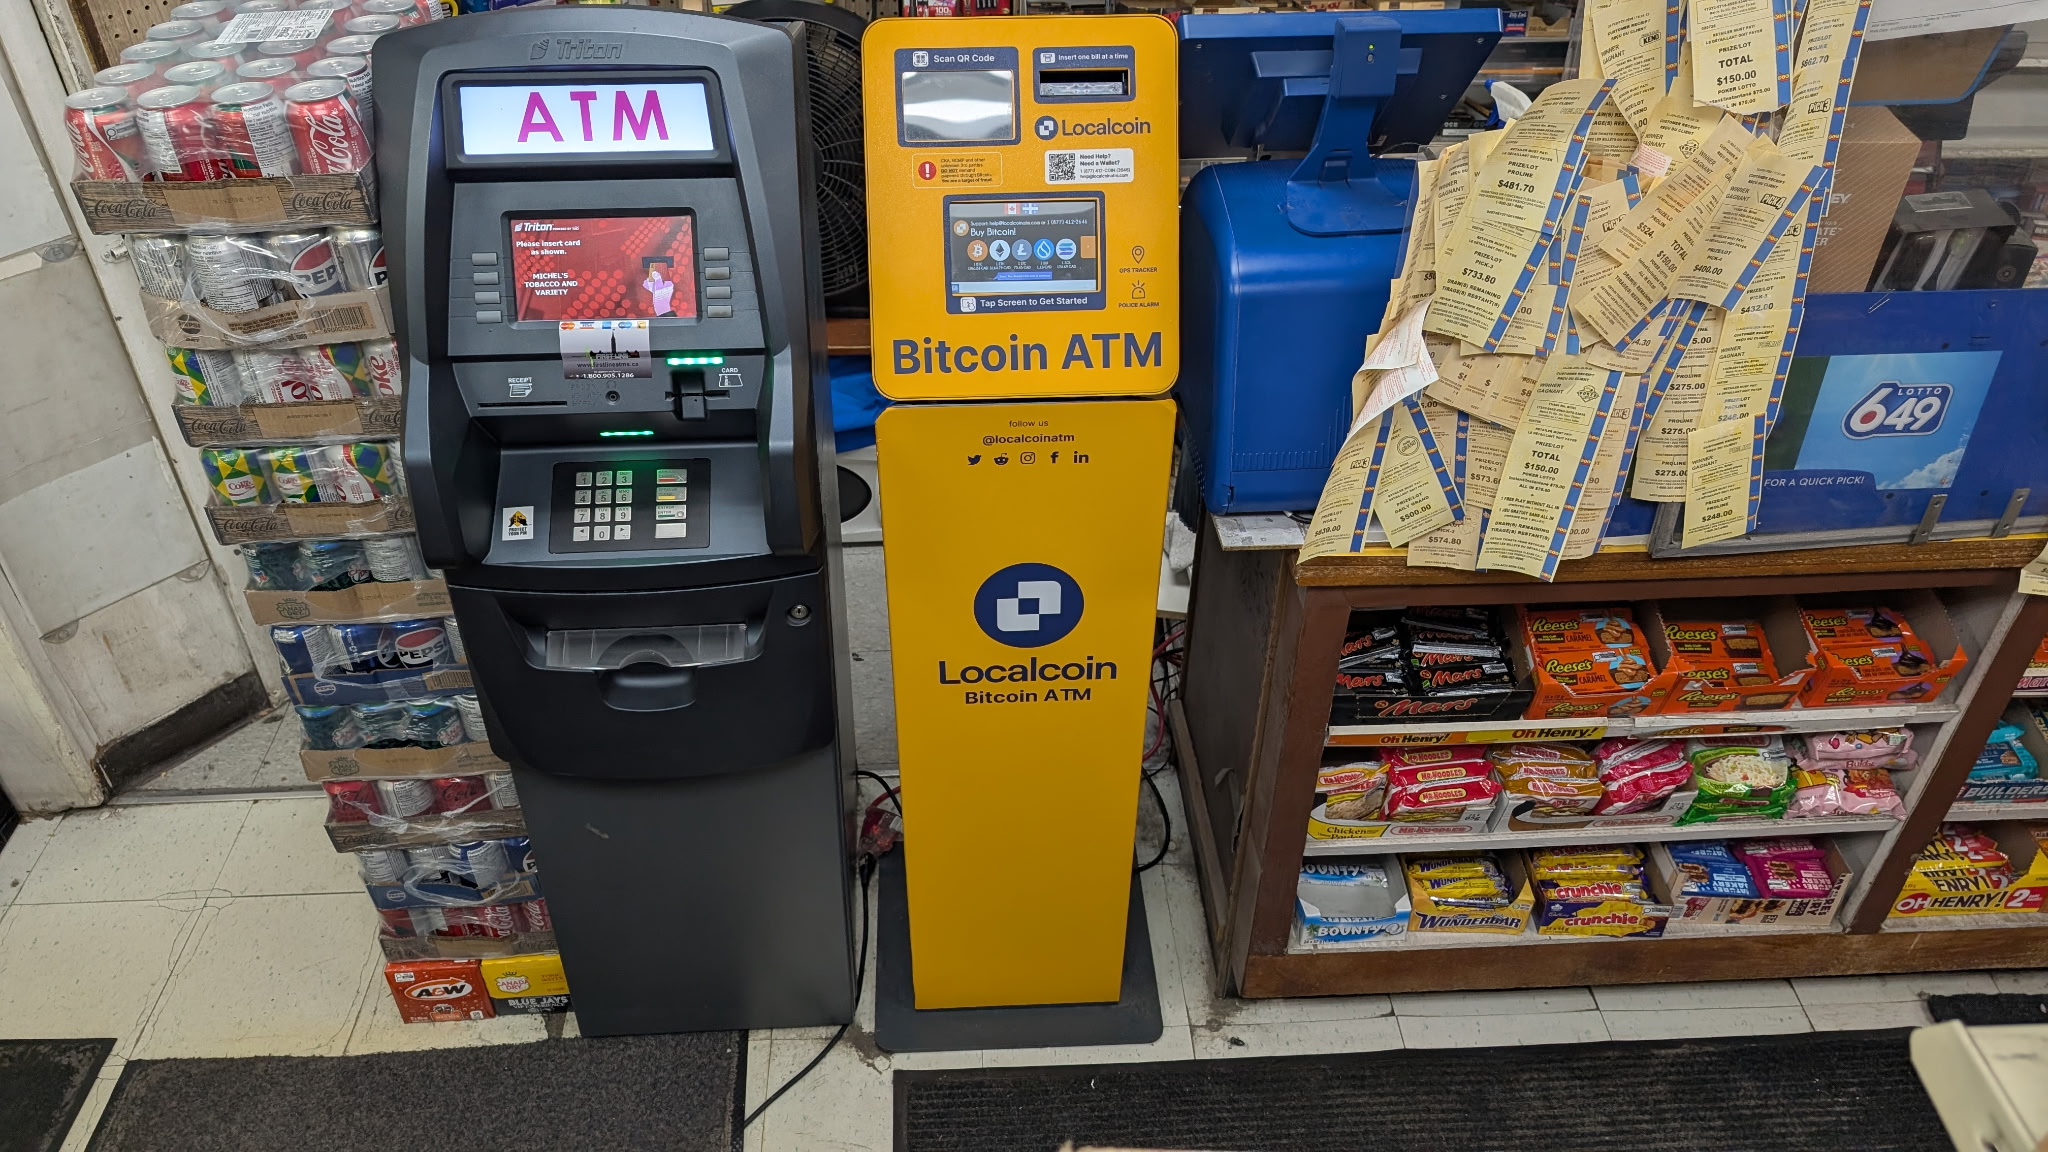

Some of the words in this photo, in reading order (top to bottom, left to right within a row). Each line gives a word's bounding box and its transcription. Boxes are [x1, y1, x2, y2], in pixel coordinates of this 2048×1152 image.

[1644, 34, 1660, 45] KENO
[557, 39, 624, 61] Triton
[1718, 42, 1753, 54] PRIZE/LOT
[934, 54, 955, 64] Scan
[957, 54, 970, 64] QR
[972, 54, 995, 63] Code
[1718, 55, 1754, 69] TOTAL
[1717, 70, 1757, 87] $150.00
[1718, 86, 1738, 95] POKER
[1738, 83, 1757, 92] LOTTO
[517, 90, 670, 143] ATM
[1062, 117, 1151, 137] Localcoin
[1508, 161, 1539, 171] PRIZE/LOT
[1508, 170, 1533, 179] PROLINE
[1498, 180, 1535, 194] $481.70
[524, 222, 554, 232] Triton
[970, 228, 984, 237] Buy
[987, 227, 1016, 236] Bitcoin!
[564, 239, 581, 247] card
[1671, 240, 1689, 261] TOTAL
[1474, 251, 1503, 264] PRIZE/LOT
[1657, 251, 1678, 273] $150.00
[1693, 264, 1723, 276] $400.00
[1462, 268, 1496, 285] $733.80
[524, 281, 561, 289] TOBACCO
[562, 280, 579, 288] AND
[1447, 279, 1469, 290] DRAW(S)
[1469, 285, 1502, 300] REMAINING
[980, 300, 996, 308] Tap
[998, 298, 1027, 307] Screen
[1056, 297, 1088, 305] Started
[1468, 292, 1500, 308] RESTANT(S)
[1741, 303, 1774, 315] $432.00
[893, 334, 1048, 375] Bitcoin
[1062, 332, 1163, 370] ATM
[508, 377, 533, 385] RECEIPT
[1670, 383, 1706, 391] $275.00
[1898, 388, 1943, 396] LOTTO
[1850, 386, 1943, 434] 649
[1009, 420, 1036, 428] follow
[983, 434, 1075, 446] @localcoinatm
[1536, 441, 1565, 450] PRIZE/LOT
[1532, 450, 1561, 462] TOTAL
[1475, 458, 1503, 467] PRIZE/LOT
[1524, 462, 1559, 475] $150.00
[583, 477, 587, 485] 1
[601, 477, 608, 485] 2
[622, 476, 628, 484] 3
[1764, 479, 1786, 489] FOR
[1789, 478, 1797, 488] A
[1800, 476, 1833, 488] QUICK
[1836, 476, 1865, 486] PICK!
[601, 495, 607, 503] 5
[621, 494, 628, 502] 6
[1396, 492, 1423, 506] PRIZE/LOT
[1705, 496, 1732, 506] PRIZE/LOT
[1400, 504, 1432, 522] $500.00
[1707, 503, 1729, 511] PROLINE
[579, 514, 586, 522] 7
[600, 513, 606, 521] 8
[621, 512, 627, 520] 9
[1702, 510, 1733, 523] $248.00
[599, 531, 606, 539] 0
[1518, 524, 1550, 534] REMAINING
[1429, 536, 1462, 545] $574.80
[1533, 618, 1580, 632] Reese's
[1807, 616, 1848, 627] Reese's
[1666, 625, 1717, 640] Reese's
[400, 638, 448, 661] PEPSI
[1421, 652, 1474, 666] Mars
[939, 656, 1118, 685] Localcoin
[1546, 660, 1593, 673] Reese's
[1337, 673, 1384, 689] Mars
[1432, 668, 1482, 687] Mars
[1579, 675, 1608, 685] CARAMEL
[965, 690, 1038, 705] Bitcoin
[1044, 688, 1092, 702] ATM
[1679, 691, 1741, 701] Reese's
[1379, 698, 1478, 717] Mars
[1380, 736, 1400, 744] Oh
[1401, 734, 1450, 744] Henry!
[1512, 729, 1536, 740] Oh
[1537, 727, 1598, 740] Henry!
[1327, 827, 1367, 835] Chicken
[1556, 883, 1623, 899] crunchie
[1896, 897, 1931, 912] OH
[1930, 891, 2009, 908] HENRY!
[2007, 889, 2031, 908] 2
[1415, 912, 1522, 929] WUNDERBAR
[1565, 913, 1639, 927] crunchie
[1318, 924, 1383, 937] BOUNTY
[417, 984, 466, 998] A&W
[508, 999, 538, 1007] BLUE
[541, 996, 569, 1004] JAYS
